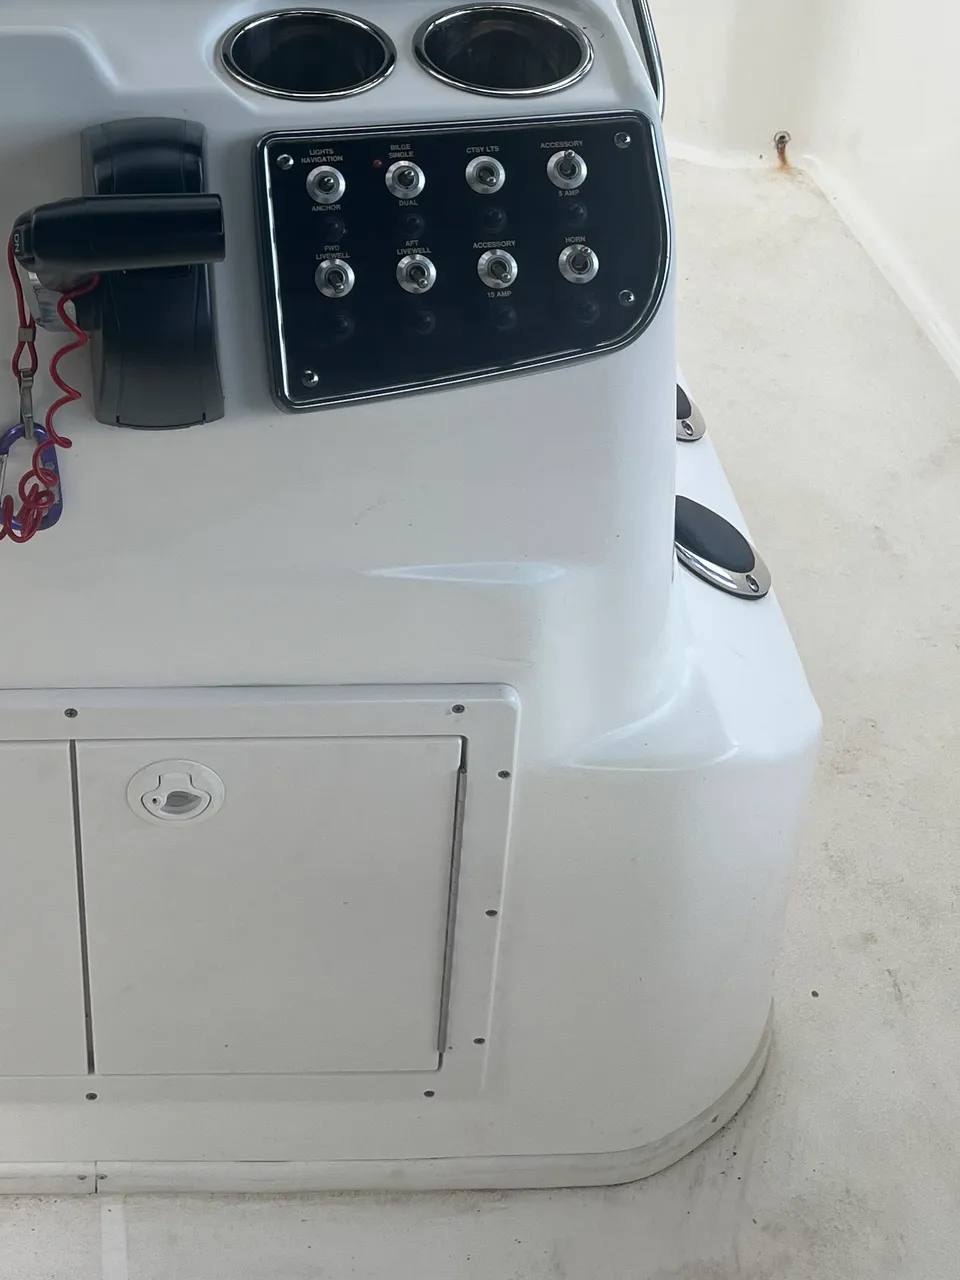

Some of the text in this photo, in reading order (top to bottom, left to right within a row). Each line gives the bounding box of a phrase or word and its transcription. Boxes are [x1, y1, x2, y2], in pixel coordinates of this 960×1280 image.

[540, 140, 583, 149] ACCESSORY
[486, 145, 499, 153] LTS
[301, 155, 343, 163] NAVIGATION
[472, 240, 516, 249] ACCESSORY
[396, 247, 431, 255] LIVEWELL
[315, 252, 350, 260] LIVEWELL
